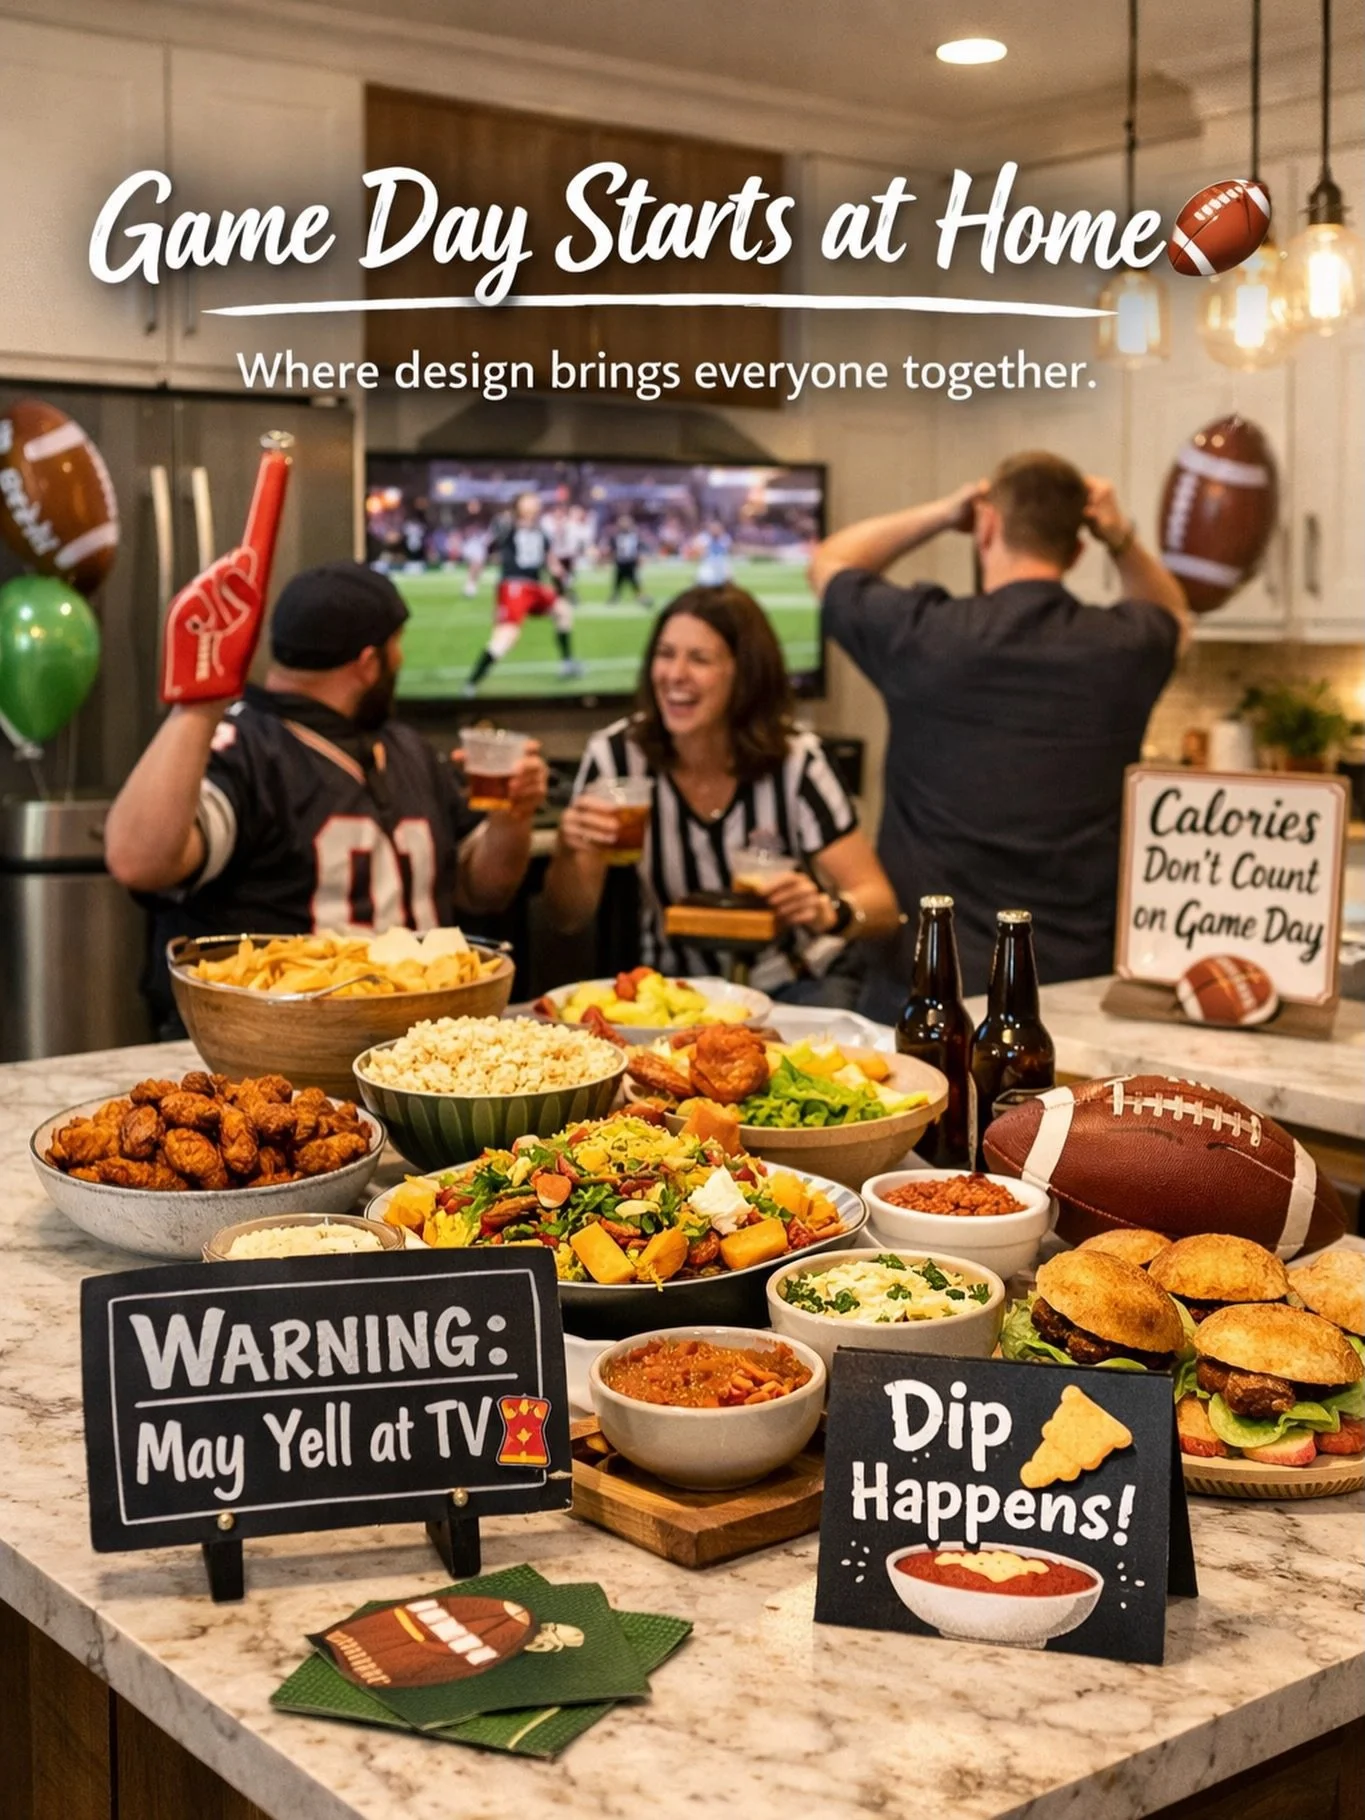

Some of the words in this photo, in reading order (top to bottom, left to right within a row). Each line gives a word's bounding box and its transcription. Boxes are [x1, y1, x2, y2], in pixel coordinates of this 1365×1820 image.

[1150, 787, 1321, 844] Calories
[1143, 845, 1221, 885] Don't
[1230, 851, 1321, 896] Count
[1132, 905, 1168, 932] on
[1173, 898, 1258, 951] Game
[1262, 905, 1326, 965] Day
[128, 1305, 510, 1391] WARNING:
[135, 1419, 245, 1502] May
[262, 1401, 353, 1473] Yell
[369, 1405, 415, 1464] at
[423, 1395, 494, 1459] TV
[883, 1379, 1014, 1472] Dip
[851, 1460, 1137, 1548] Happens!
